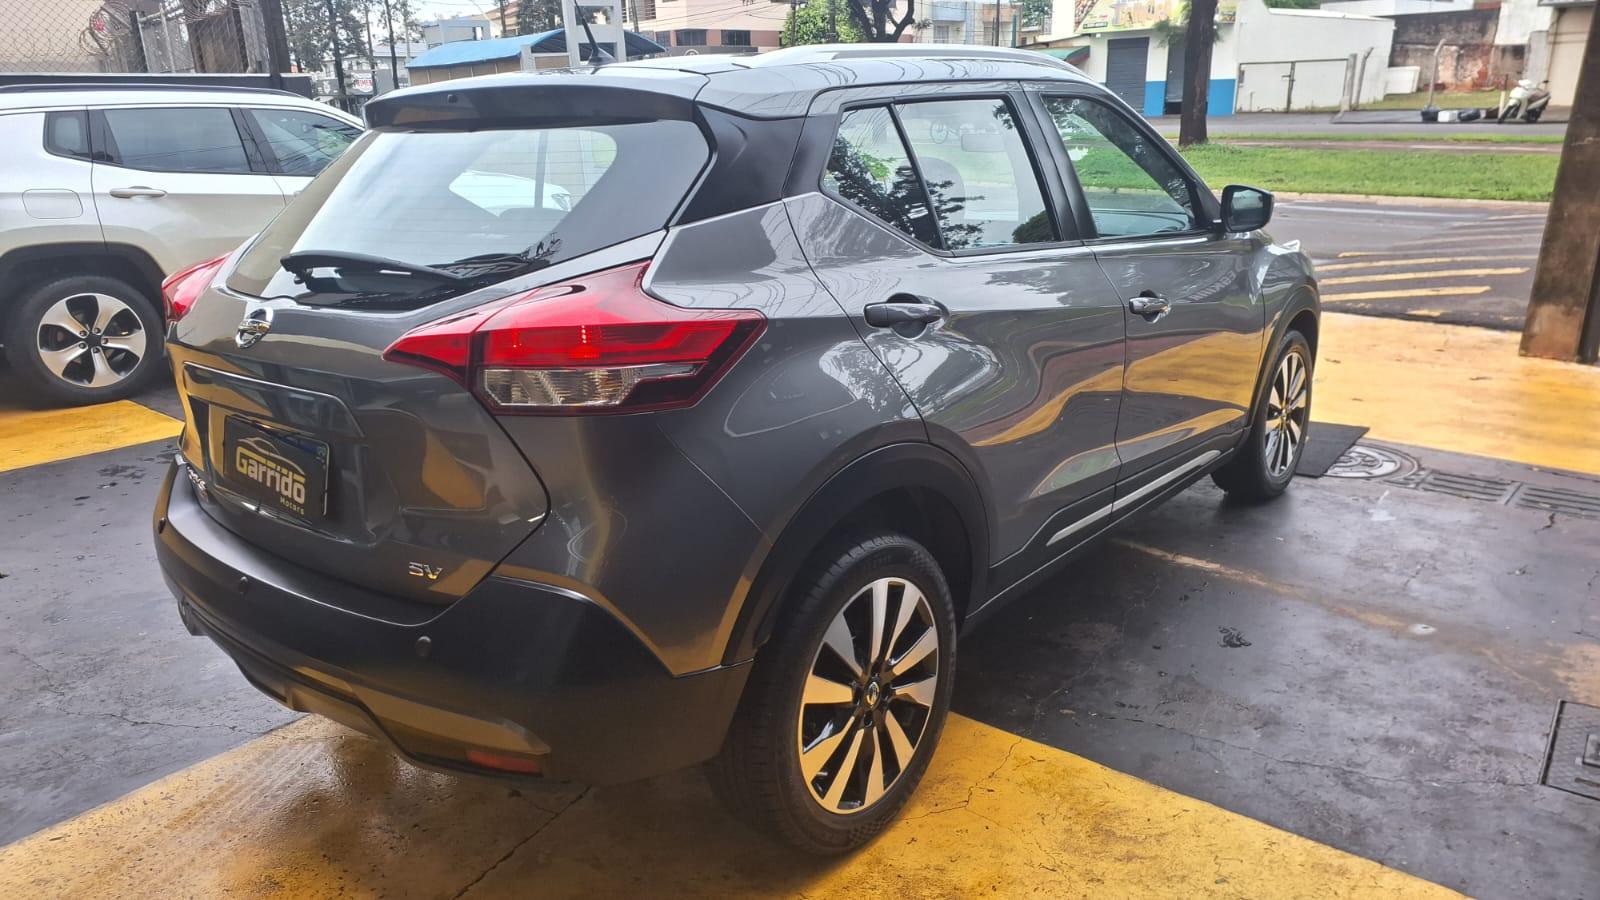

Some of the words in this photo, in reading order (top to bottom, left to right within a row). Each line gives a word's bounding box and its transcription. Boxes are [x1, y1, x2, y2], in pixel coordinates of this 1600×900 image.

[236, 446, 306, 505] Garrido
[279, 496, 305, 515] Motors
[408, 561, 443, 580] SV
